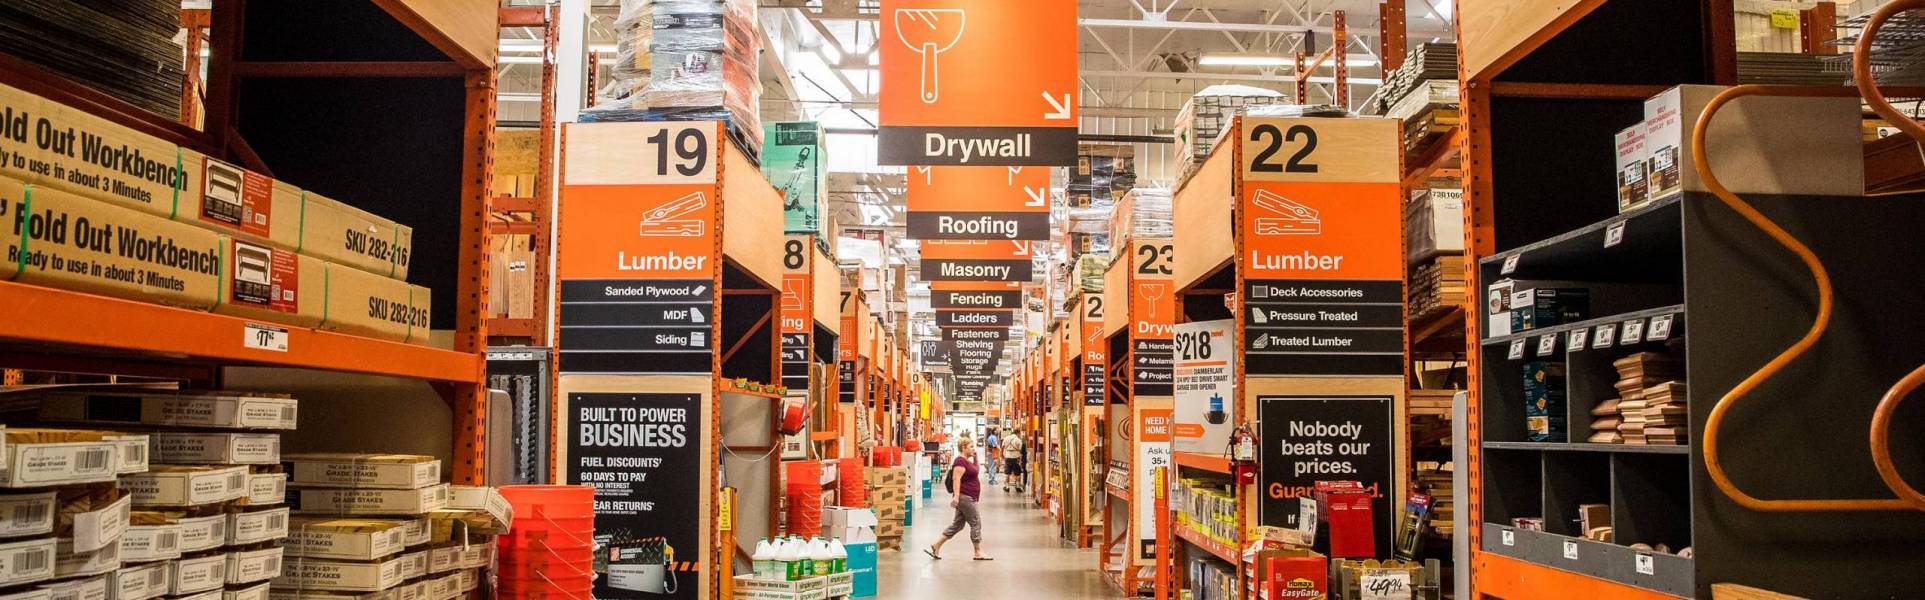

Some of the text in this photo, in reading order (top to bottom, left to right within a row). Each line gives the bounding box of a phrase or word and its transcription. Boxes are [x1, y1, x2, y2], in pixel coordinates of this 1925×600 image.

[0, 106, 188, 192] old Out Workbench
[647, 127, 708, 177] 19
[926, 134, 1030, 162] Drywall
[1250, 124, 1318, 173] 22
[13, 150, 25, 171] to
[28, 156, 50, 175] use
[54, 160, 65, 178] in
[68, 165, 100, 190] about
[103, 173, 110, 191] 3
[112, 177, 152, 204] Minutes
[939, 216, 1018, 237] Roofing
[14, 200, 66, 245] Fold
[74, 216, 112, 255] Out
[118, 228, 219, 276] Workbench
[346, 229, 407, 266] SKU 282-216
[784, 240, 804, 269] 8
[618, 251, 705, 271] Lumber
[1252, 250, 1343, 270] Lumber
[52, 254, 64, 270] to
[67, 259, 89, 276] use
[91, 261, 102, 275] in
[104, 263, 135, 286] about
[138, 268, 144, 284] 3
[146, 270, 185, 292] Minutes
[941, 263, 1010, 280] Masonry
[605, 285, 689, 298] Sanded Plywood
[1270, 288, 1363, 298] Deck Accessories
[840, 291, 851, 313] 7
[950, 293, 1002, 307] Fencing
[1088, 297, 1102, 318] 2
[369, 296, 427, 328] SKU 282-216
[664, 310, 688, 320] MDF
[952, 313, 997, 323] Ladders
[1270, 311, 1358, 321] Pressure Treated
[952, 330, 999, 339] Fasteners
[1138, 321, 1174, 335] Dryw
[656, 335, 687, 346] Siding
[956, 340, 993, 349] Shelving
[1176, 331, 1211, 360] $218
[1270, 337, 1352, 346] Treated Lumber
[960, 350, 992, 358] Flooring
[1149, 372, 1171, 380] Project
[580, 408, 686, 423] BUILT TO POWER
[580, 424, 686, 447] BUSINESS
[1146, 426, 1166, 434] HOME
[1290, 421, 1362, 439] Nobody
[1282, 440, 1370, 455] beats our
[581, 457, 604, 467] FUEL
[1295, 458, 1357, 477] prices.
[581, 473, 646, 482] 60 DAYS TO PAY
[594, 502, 610, 510] EAR
[1288, 514, 1295, 524] If
[1282, 589, 1319, 597] EasyGate
